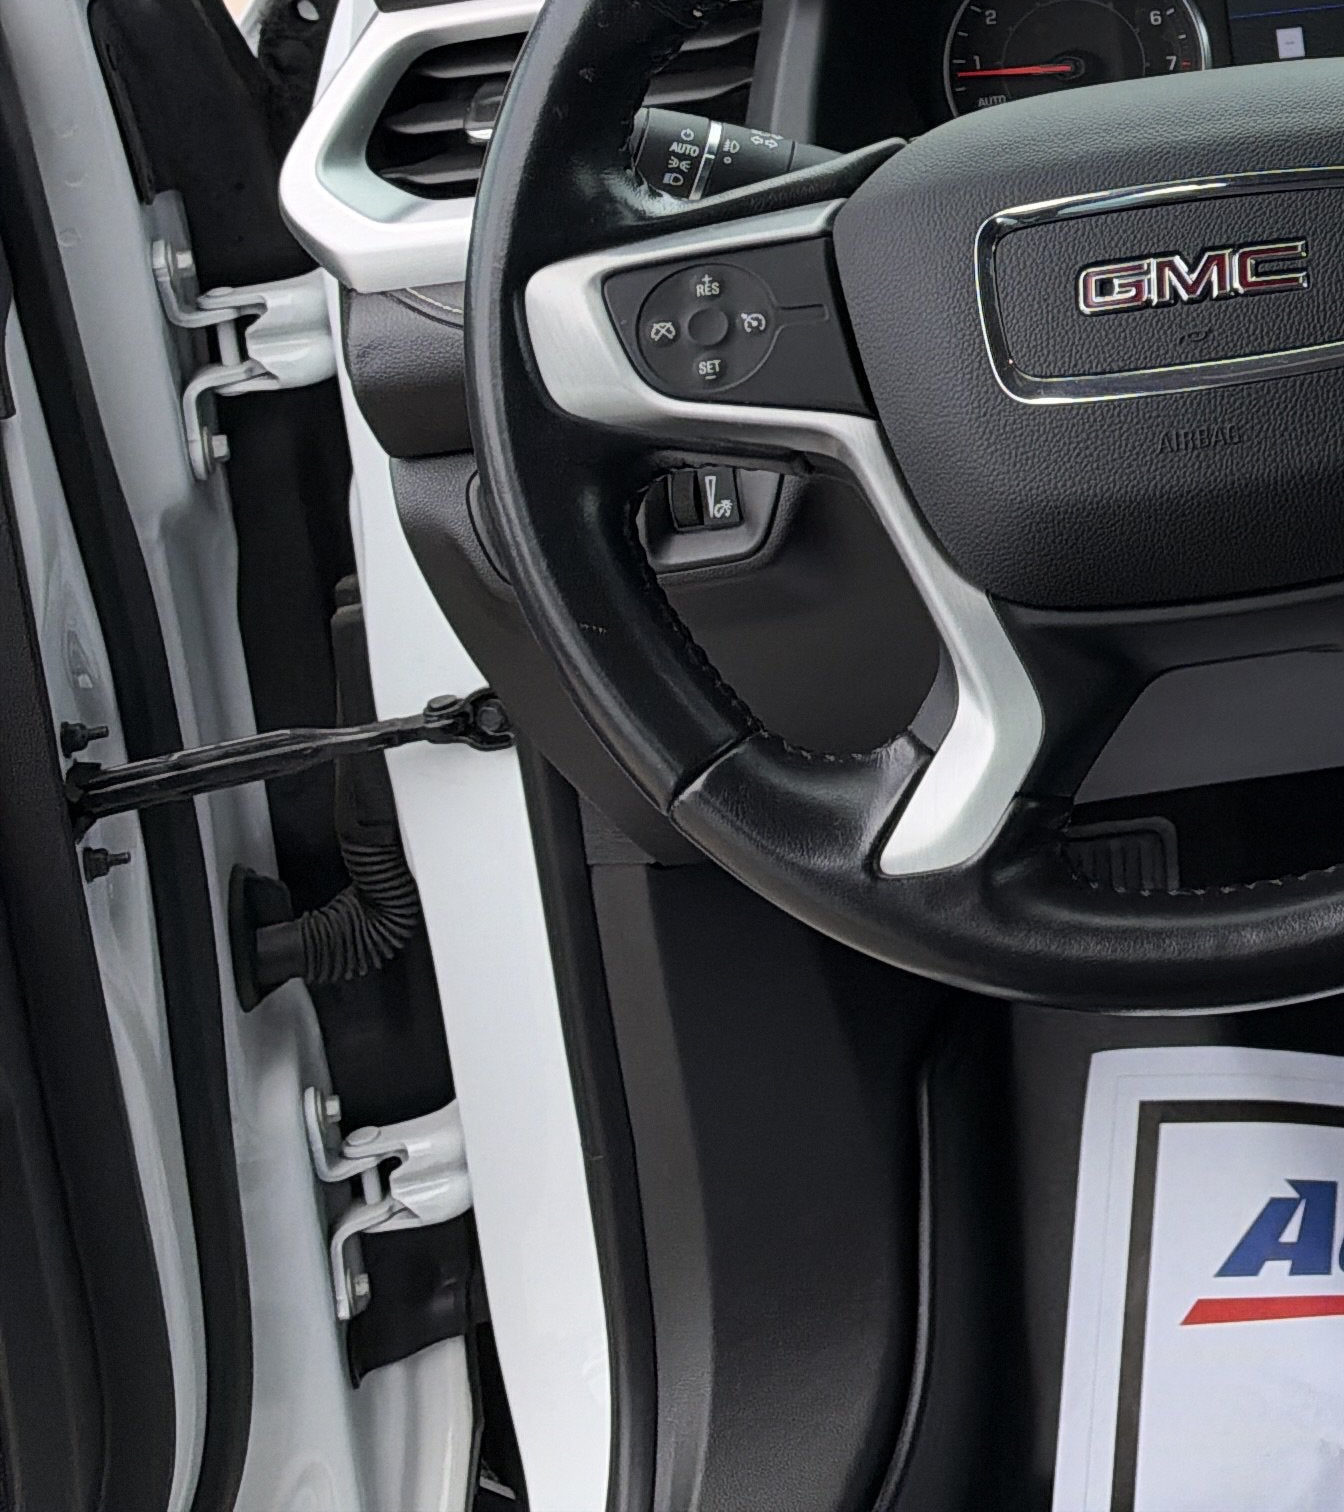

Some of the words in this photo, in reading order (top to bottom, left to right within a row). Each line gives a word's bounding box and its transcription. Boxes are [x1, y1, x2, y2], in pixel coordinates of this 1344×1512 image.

[985, 10, 998, 25] 2
[1150, 10, 1162, 25] 6
[1166, 56, 1177, 71] 7
[977, 94, 1007, 108] AUTO
[669, 141, 700, 158] AUTO
[1078, 239, 1310, 316] GMC
[696, 282, 720, 298] RES
[698, 359, 722, 375] SET
[1158, 424, 1243, 454] AIRBAG
